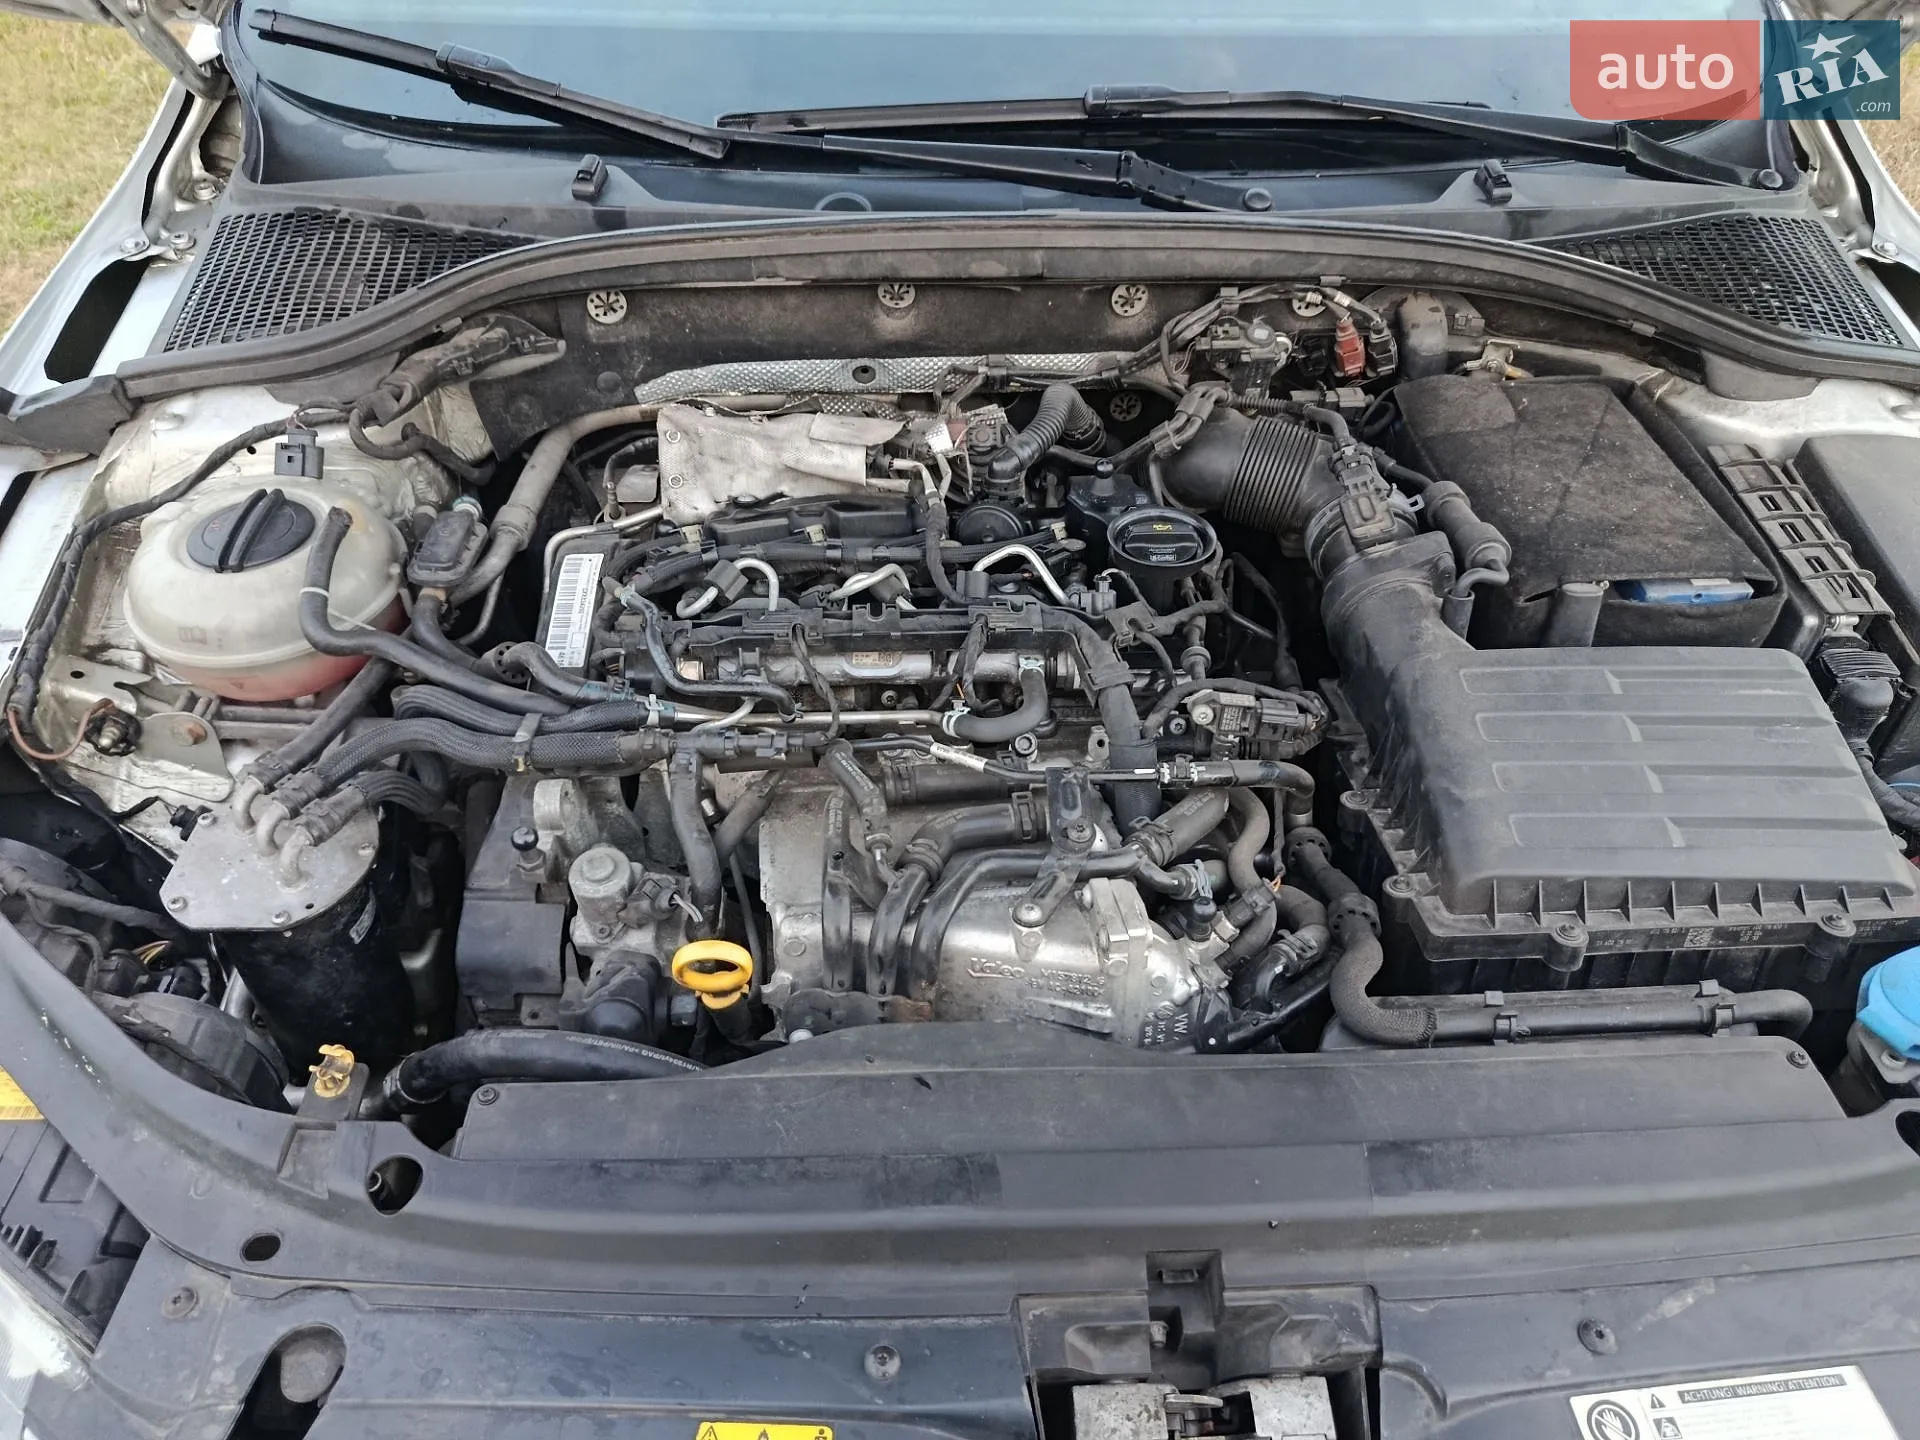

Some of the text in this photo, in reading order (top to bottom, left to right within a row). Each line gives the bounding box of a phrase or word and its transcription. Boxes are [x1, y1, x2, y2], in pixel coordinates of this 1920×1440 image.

[1682, 1374, 1840, 1401] ACHTUNG! WARNING! ATTENTION
